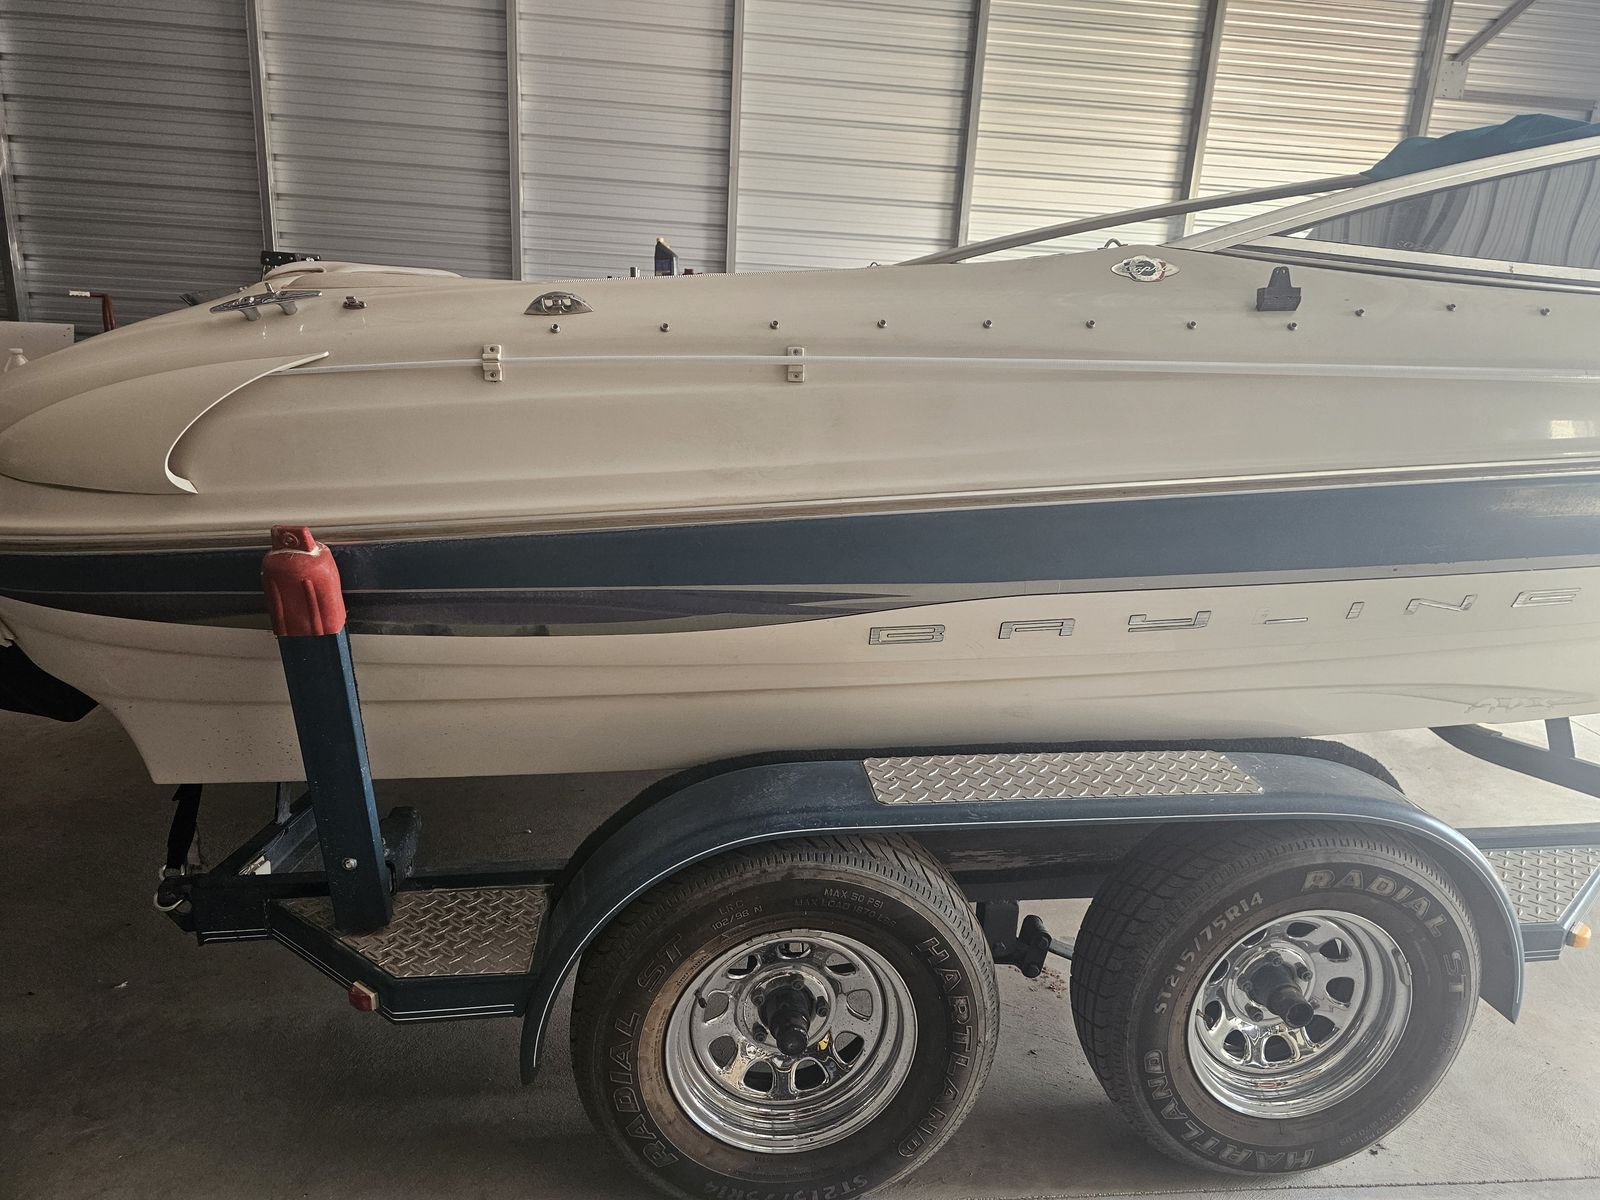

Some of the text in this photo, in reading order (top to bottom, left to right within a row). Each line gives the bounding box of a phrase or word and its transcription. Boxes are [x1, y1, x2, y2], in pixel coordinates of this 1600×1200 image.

[867, 586, 1582, 646] BAYLINE
[823, 887, 884, 909] MAX 50 PSI
[1152, 890, 1265, 1016] ST215/75R14
[1300, 868, 1468, 1003] RADIAL ST
[609, 931, 685, 1169] RADIAL ST
[897, 936, 973, 1159] HARTLAND
[1142, 1048, 1317, 1173] HARTLAND
